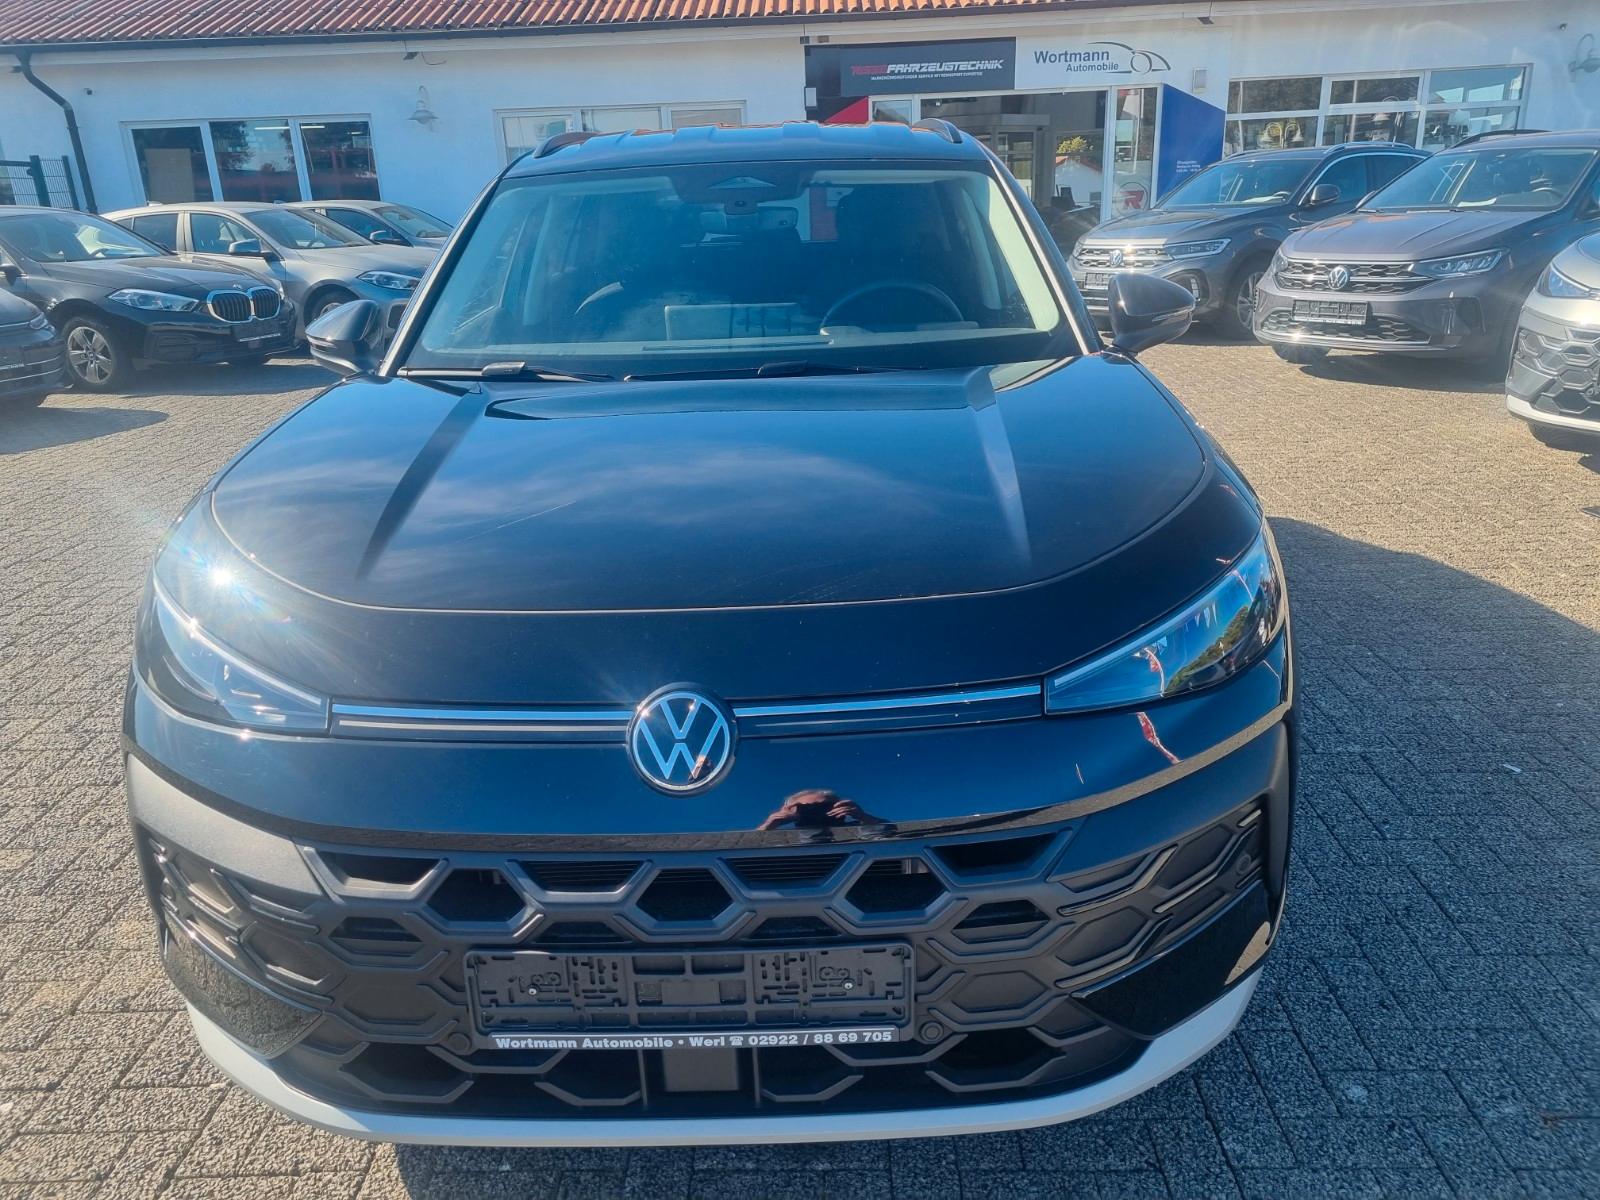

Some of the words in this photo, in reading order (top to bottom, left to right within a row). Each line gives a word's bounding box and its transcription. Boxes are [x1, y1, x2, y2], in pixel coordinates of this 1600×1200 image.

[1034, 50, 1110, 64] Wortmann
[1065, 62, 1119, 72] Automobile
[634, 692, 730, 790] VW
[496, 1037, 577, 1049] Wortmann
[582, 1037, 673, 1048] Automobile
[689, 1036, 725, 1047] Werl
[748, 1035, 798, 1046] 02922
[813, 1033, 833, 1044] 88
[838, 1033, 858, 1043] 69
[863, 1031, 892, 1042] 705
